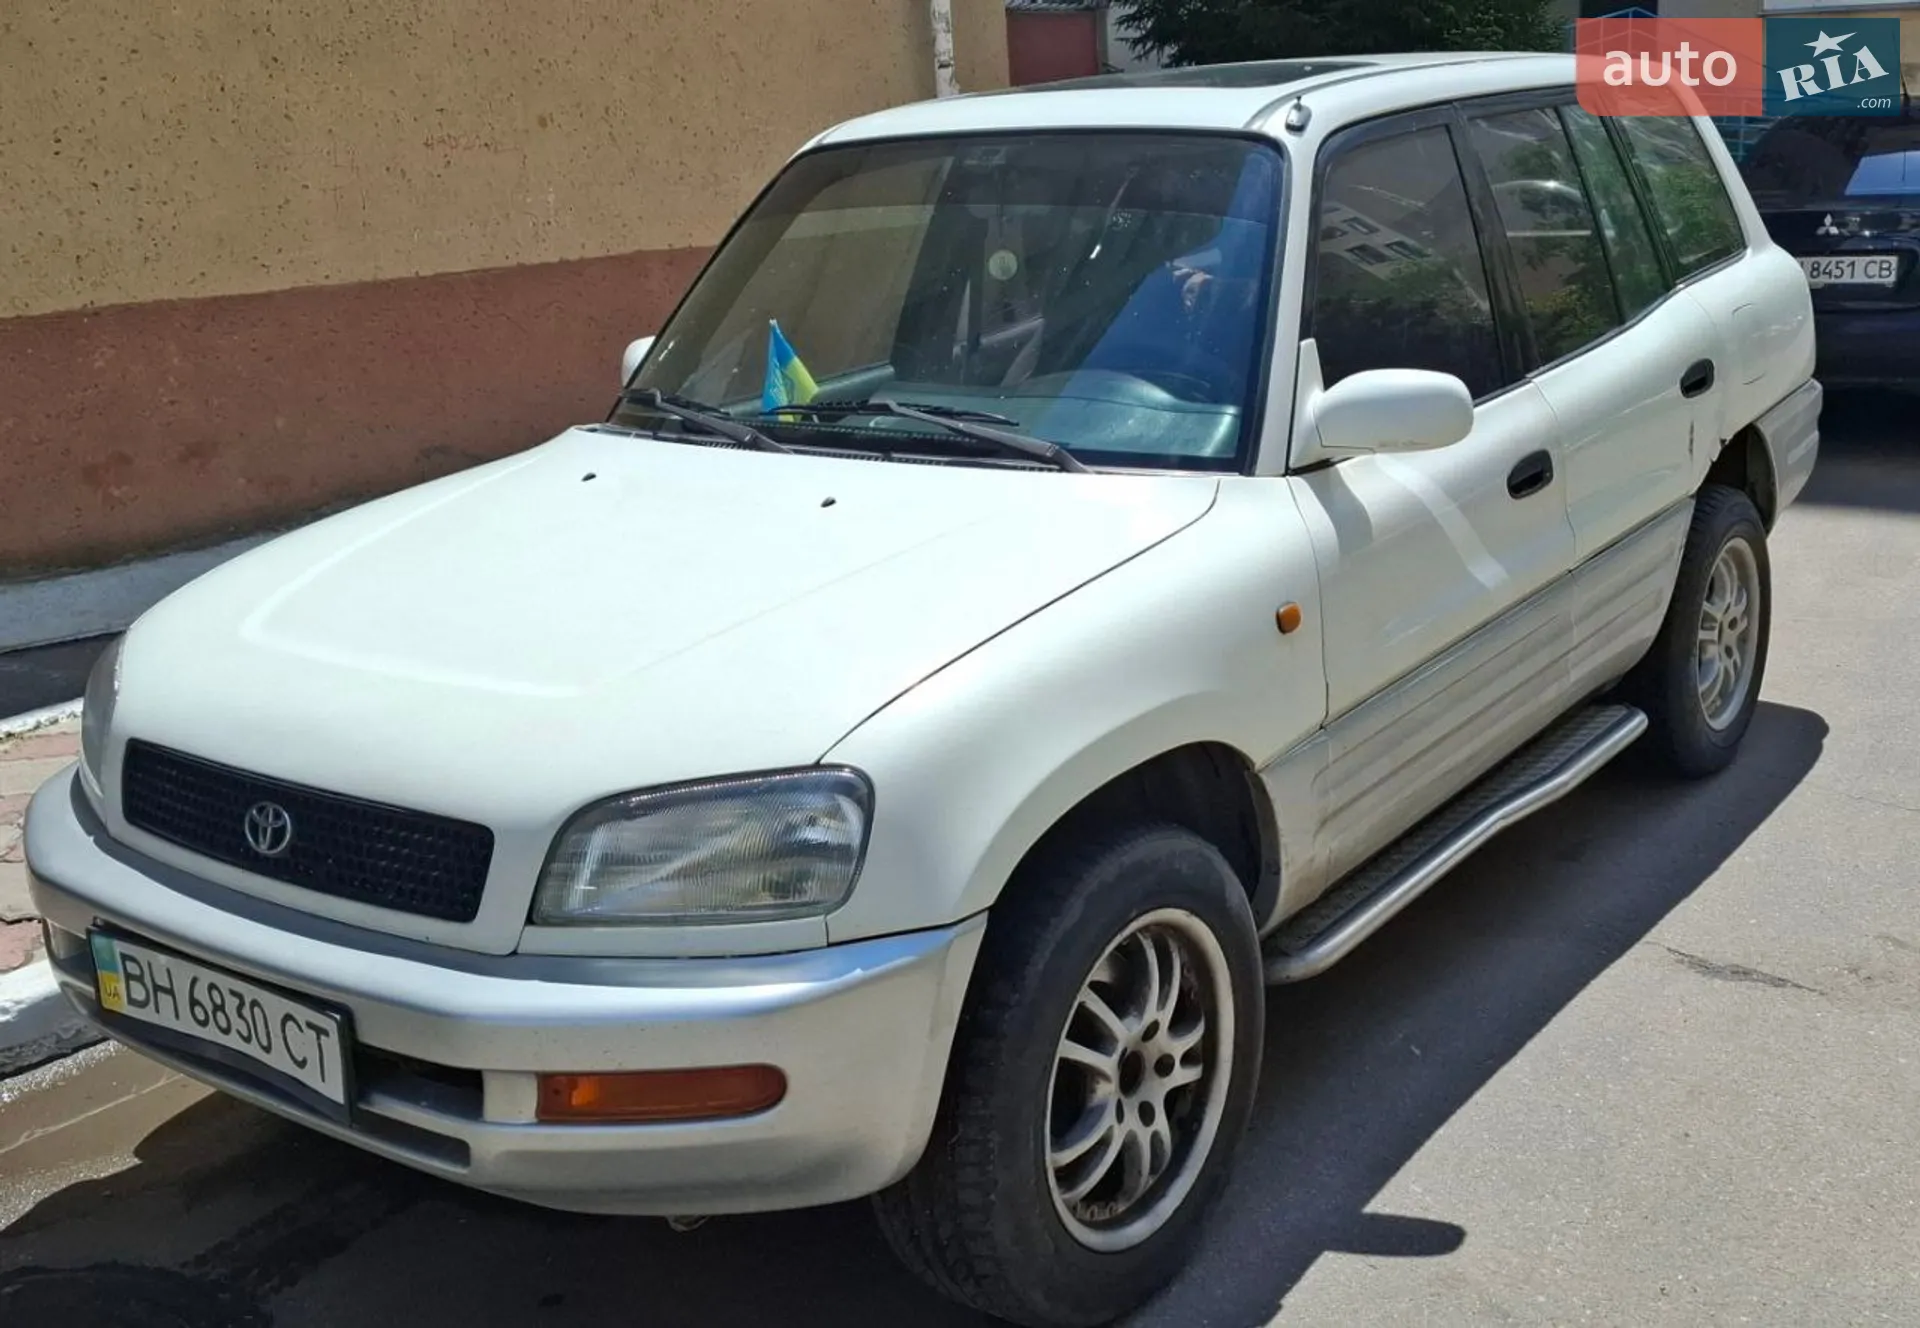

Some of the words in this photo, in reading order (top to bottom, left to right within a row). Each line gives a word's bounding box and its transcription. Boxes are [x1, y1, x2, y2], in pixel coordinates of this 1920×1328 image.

[1810, 260, 1856, 280] 8451
[1864, 260, 1893, 279] CB
[104, 982, 120, 999] UA
[120, 952, 179, 1021] BH
[188, 976, 272, 1055] 6830
[280, 1012, 330, 1084] CT
